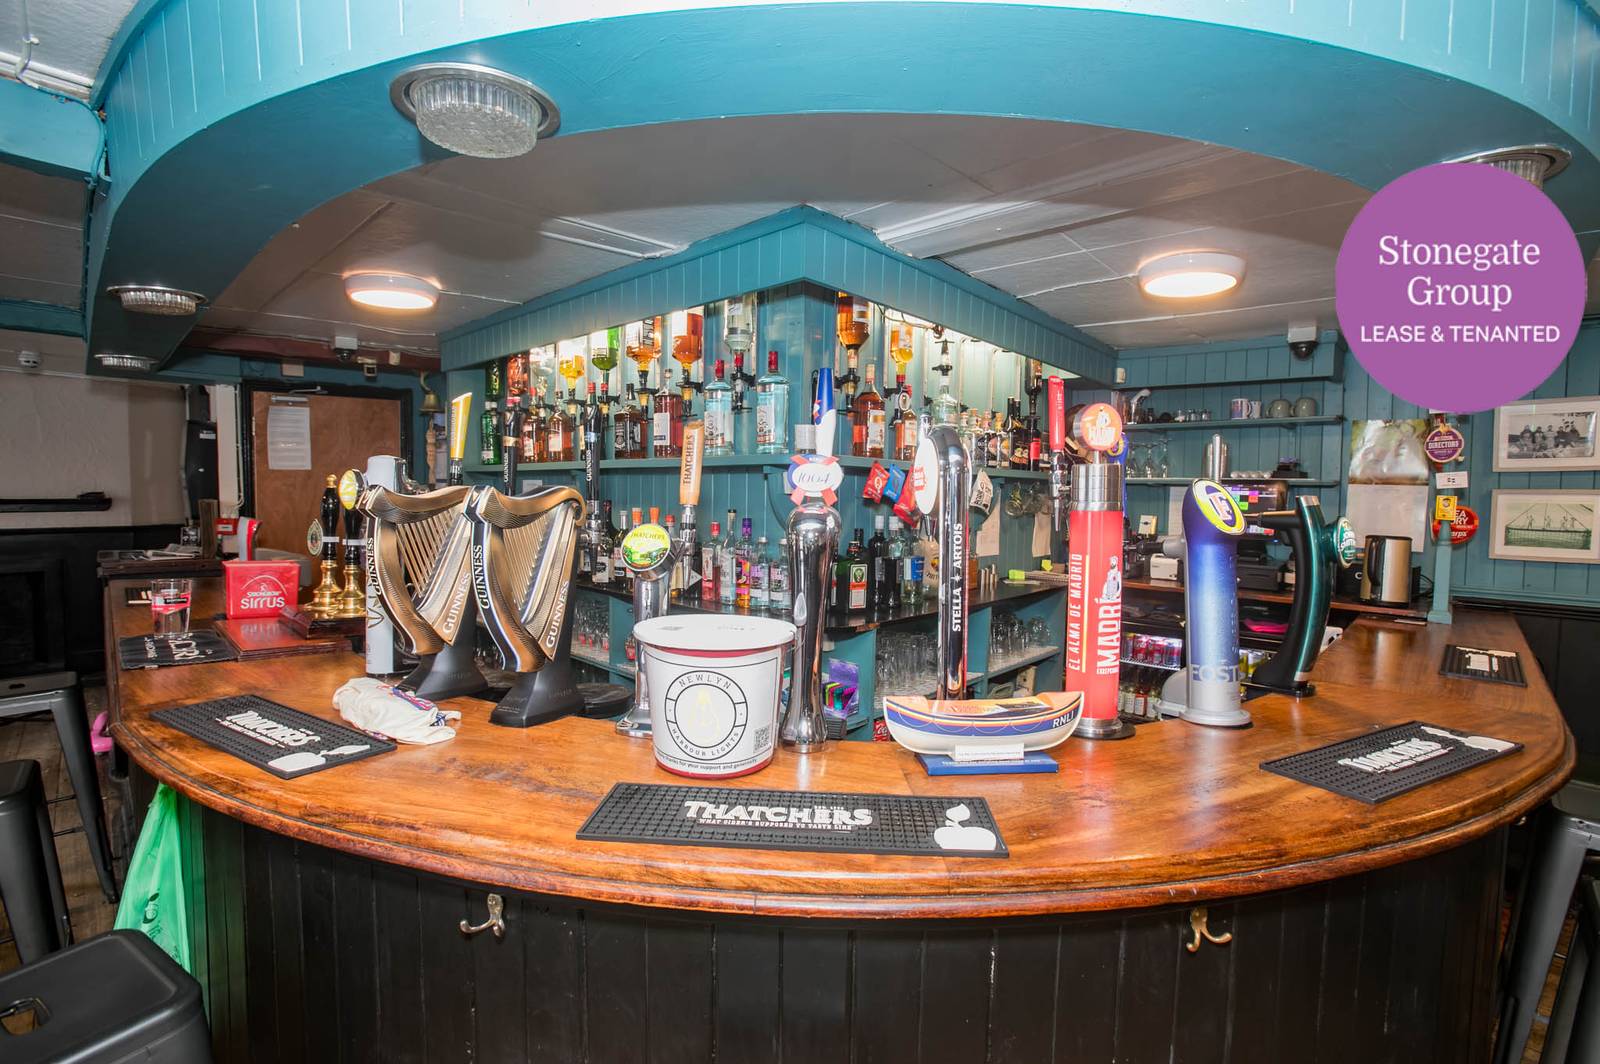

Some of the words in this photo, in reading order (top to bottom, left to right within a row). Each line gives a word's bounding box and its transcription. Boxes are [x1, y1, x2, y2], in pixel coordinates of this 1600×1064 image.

[682, 435, 695, 485] THATCHERS
[953, 523, 963, 569] ARTOIS
[367, 537, 383, 596] GUINNESS
[474, 545, 491, 610] GUINNESS
[1070, 553, 1083, 600] MADRID
[442, 571, 471, 634] GUINNESS
[545, 581, 570, 648] GUINNESS
[952, 586, 962, 632] STELLA
[1069, 603, 1082, 617] DE
[1068, 622, 1081, 655] ALMA
[679, 673, 732, 690] NEWLYN
[1068, 658, 1081, 671] EL
[1052, 710, 1076, 729] RNLI
[671, 728, 706, 757] HARBOUR
[711, 732, 739, 756] LIGHTS
[684, 801, 873, 825] THATCHERS
[755, 821, 793, 829] SUPPOSED
